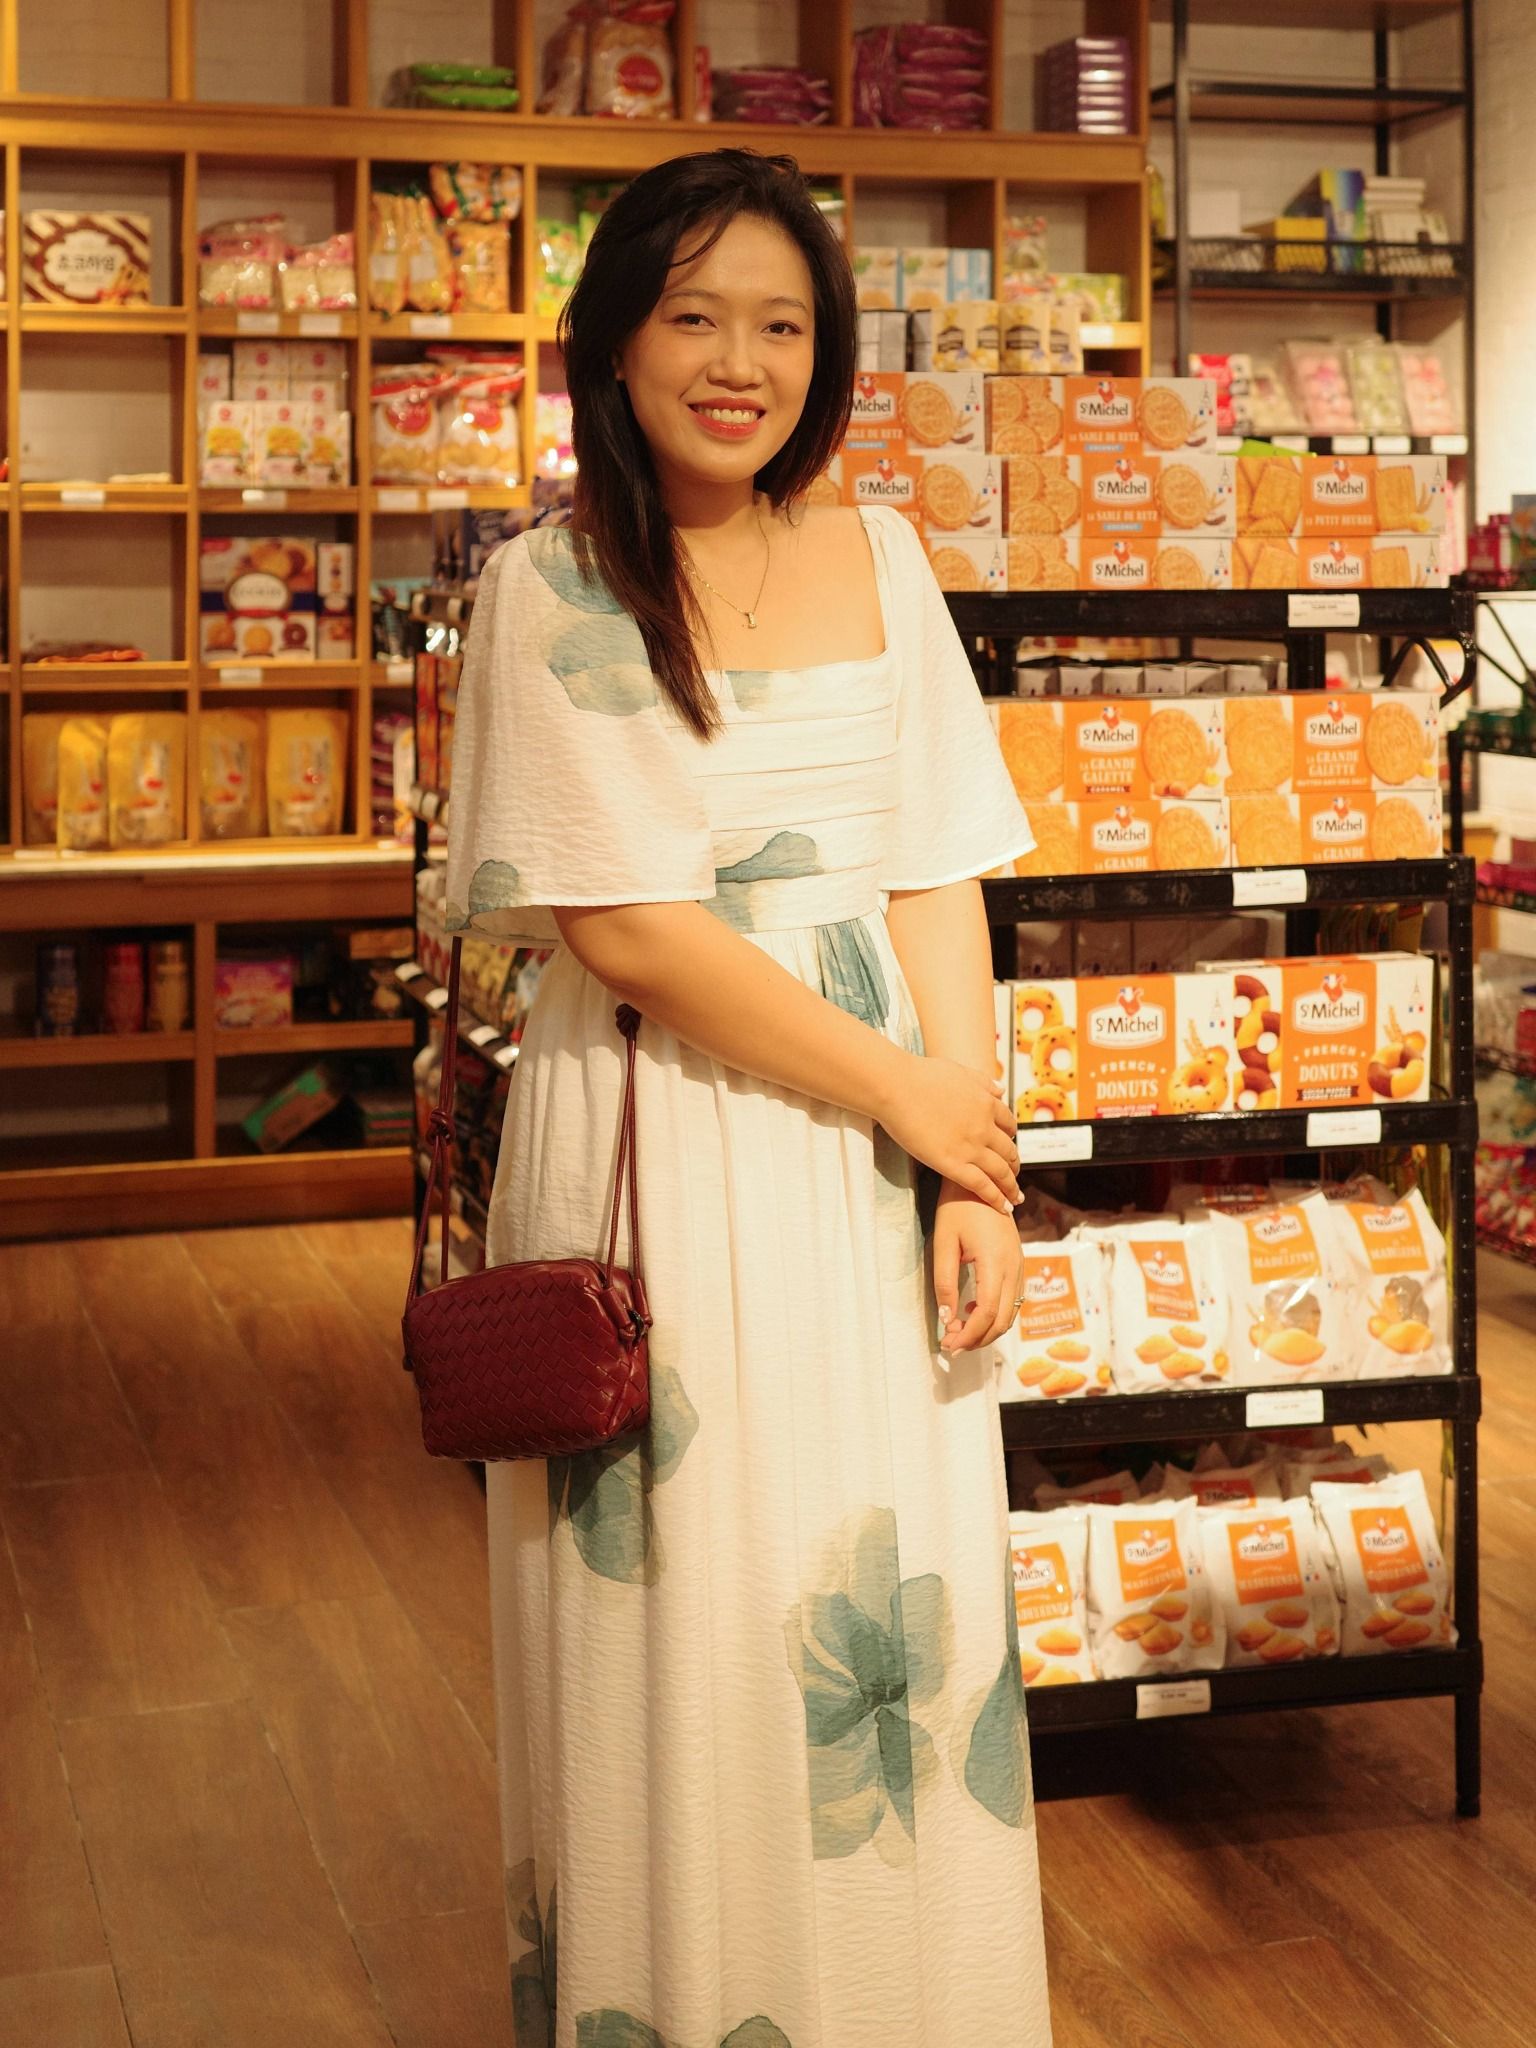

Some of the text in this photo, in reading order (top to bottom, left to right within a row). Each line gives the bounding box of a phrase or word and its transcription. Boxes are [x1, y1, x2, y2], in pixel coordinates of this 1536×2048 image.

[1089, 403, 1128, 415] Michel
[868, 480, 909, 494] Michel
[1106, 480, 1146, 494] Michel
[1325, 481, 1363, 494] Michel
[1104, 563, 1143, 576] Michel
[1322, 562, 1359, 575] Michel
[1319, 721, 1357, 735] Michel
[1092, 729, 1134, 741] Michel
[1316, 750, 1359, 762] GRANDE
[1090, 758, 1136, 769] GRANDE
[1309, 763, 1356, 777] GALETTE
[1082, 771, 1133, 784] GALETTE
[1325, 818, 1362, 832] Michel
[1106, 828, 1145, 841] Michel
[1323, 847, 1364, 860] GRANDE
[1104, 856, 1147, 869] GRANDE
[1311, 1001, 1359, 1018] Michel
[1107, 1016, 1158, 1033] Michel
[1304, 1044, 1356, 1058] FRENCH
[1100, 1060, 1156, 1074] FRENCH
[1299, 1062, 1358, 1083] DONUTS
[1096, 1078, 1159, 1100] DONUTS
